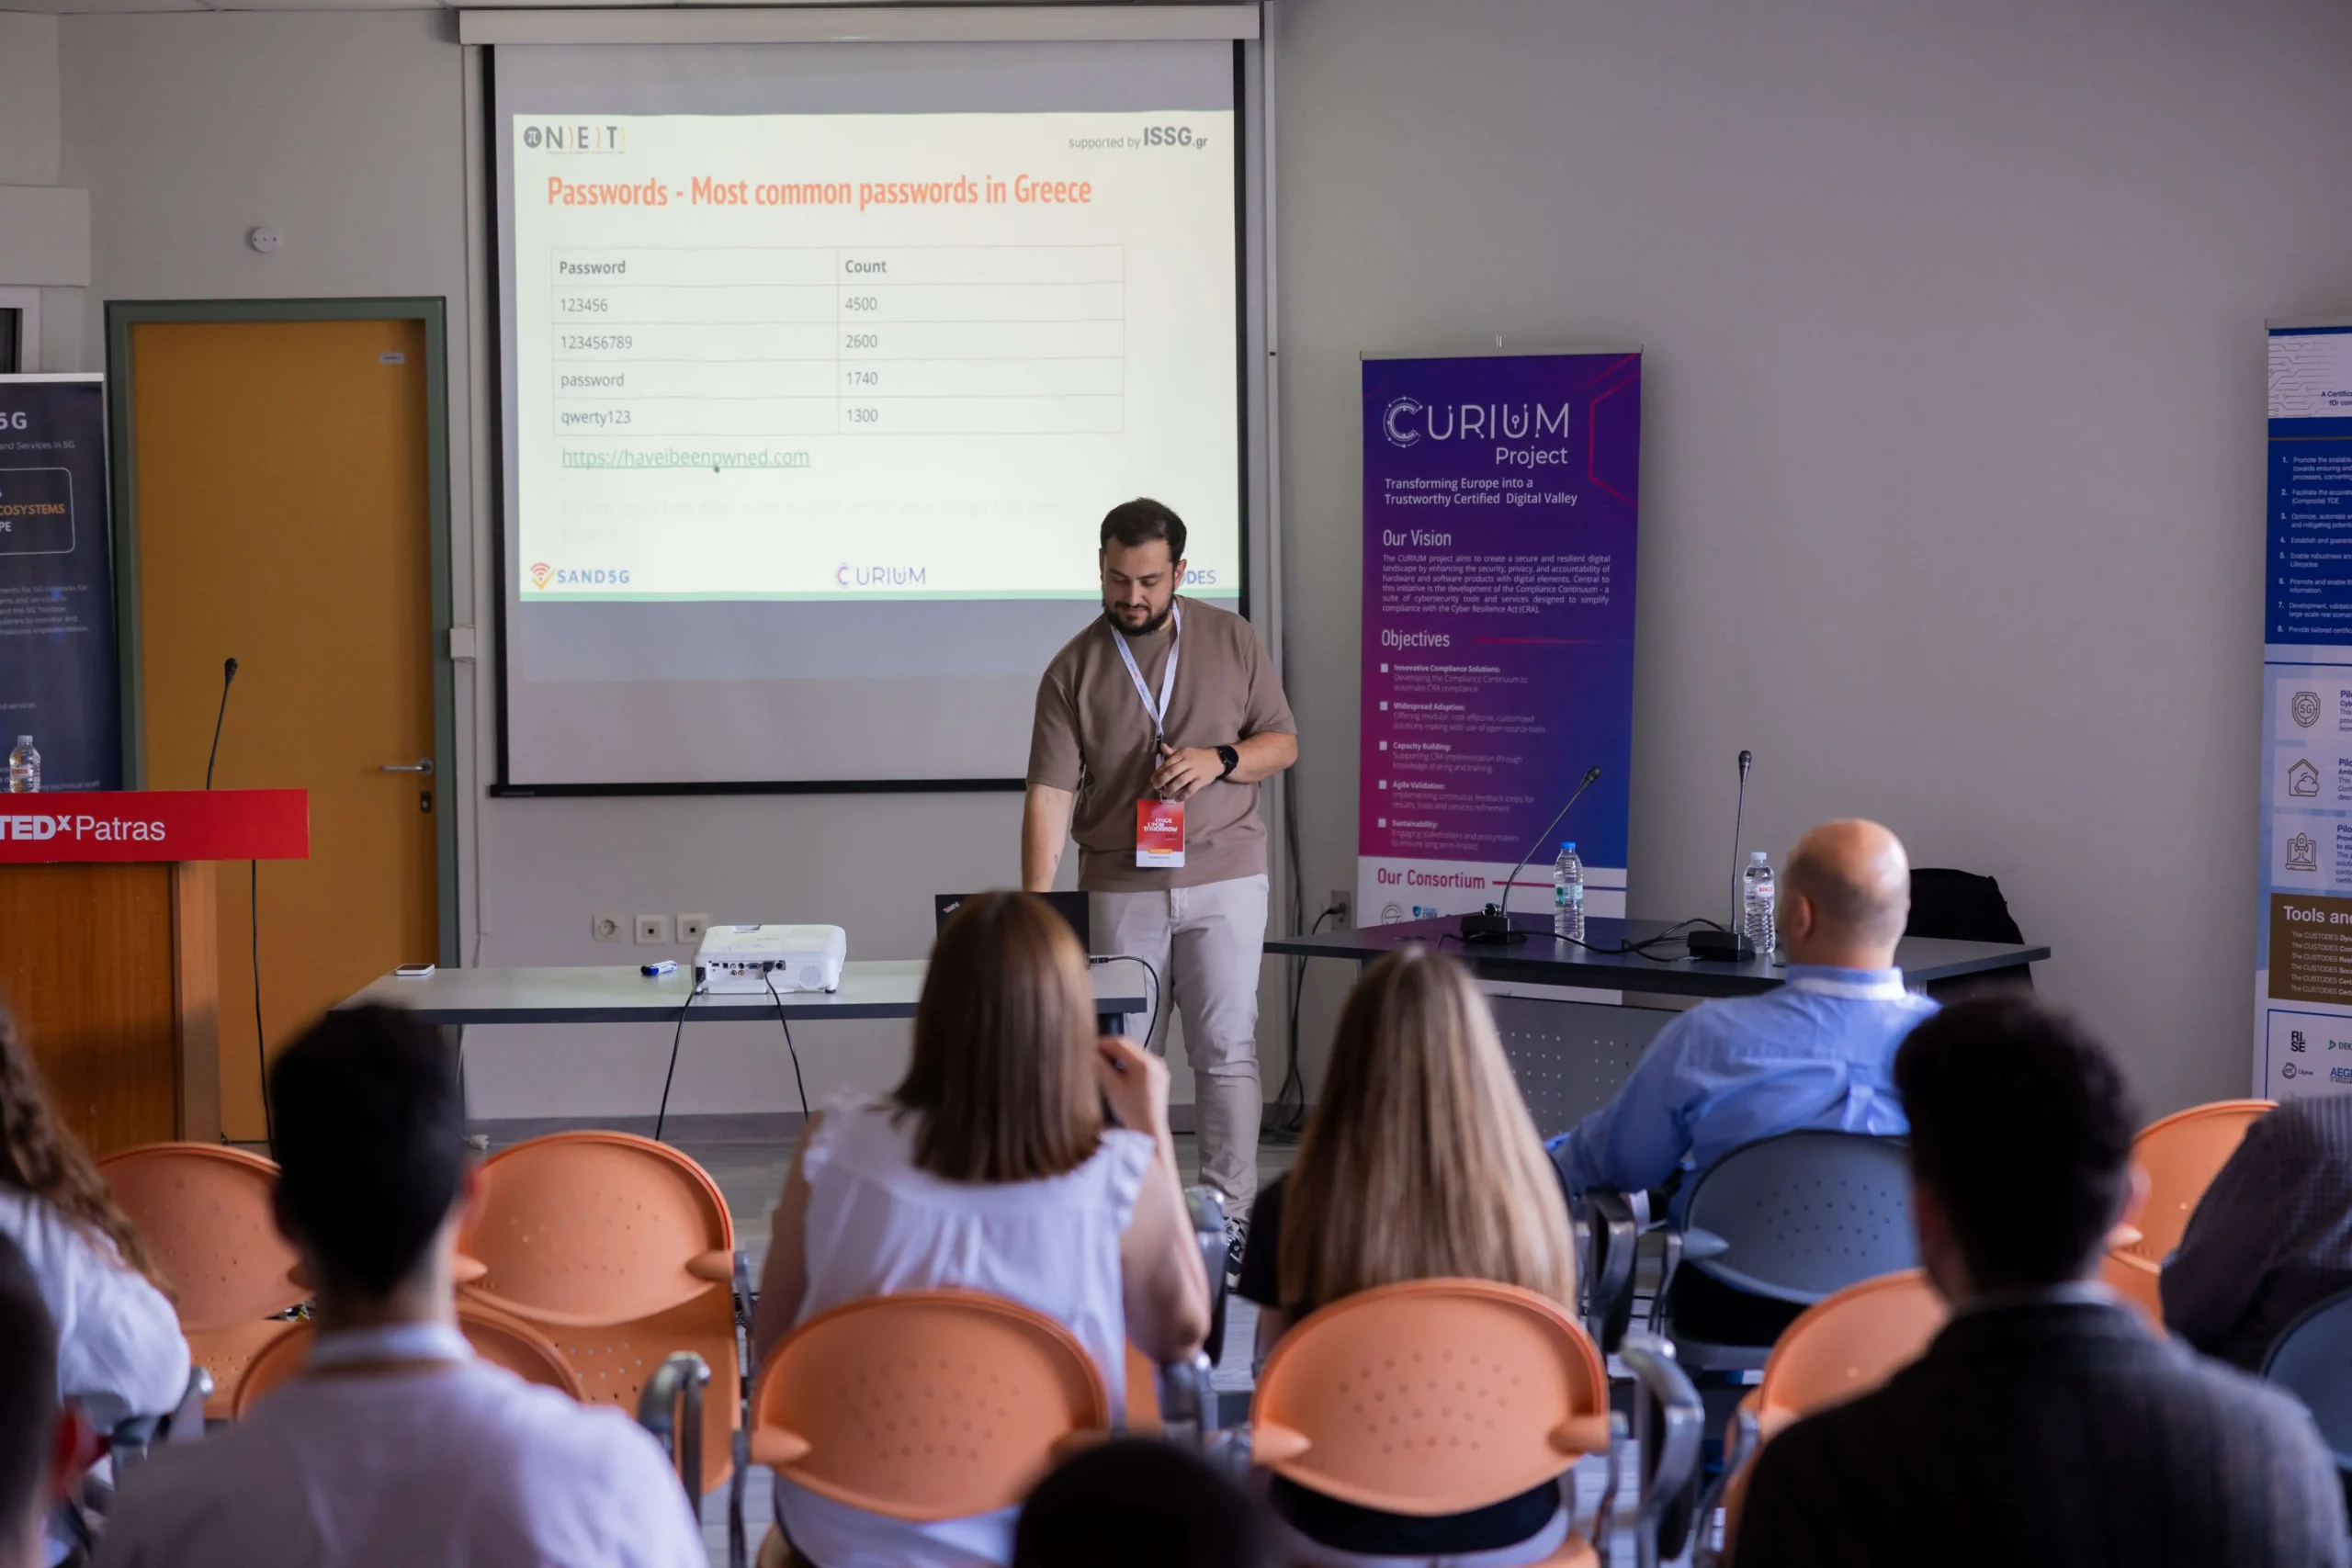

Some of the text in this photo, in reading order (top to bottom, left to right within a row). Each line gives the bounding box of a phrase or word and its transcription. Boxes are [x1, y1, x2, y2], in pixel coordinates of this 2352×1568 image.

[1069, 127, 1208, 150] supported by ISSG.gr
[548, 176, 668, 206] Passwords
[691, 176, 748, 206] Most
[755, 182, 852, 206] common
[860, 175, 978, 210] passwords
[985, 175, 1006, 204] in
[1014, 174, 1091, 204] Greece
[560, 260, 626, 275] Password
[844, 260, 887, 274] Count
[560, 298, 608, 312] 123456
[844, 297, 877, 311] 4500
[560, 335, 633, 350] 123456789
[845, 334, 878, 348] 2600
[560, 373, 625, 389] password
[845, 372, 878, 386] 1740
[560, 411, 631, 427] qwerty123
[846, 409, 878, 423] 1300
[1383, 396, 1569, 448] CURIUM
[16, 442, 52, 450] Services
[561, 447, 810, 469] https://haveibeenpwned.com
[1496, 446, 1568, 468] Project
[1385, 478, 1533, 491] Transforming Europe into a
[1385, 492, 1577, 507] Trustworthy Certified Digital Valley
[1383, 529, 1452, 547] Our Vision
[1398, 555, 1426, 563] CURIUM
[1430, 555, 1453, 564] project
[1541, 555, 1555, 563] and
[1557, 555, 1585, 563] resilient
[1588, 555, 1611, 564] digital
[557, 569, 630, 584] SAND5G
[836, 563, 926, 589] CURIUM
[1383, 565, 1417, 574] landscape
[1419, 565, 1427, 574] by
[1429, 565, 1464, 574] enhancing
[1478, 565, 1507, 574] security,
[1536, 565, 1550, 573] and
[1552, 565, 1600, 574] accountability
[1602, 565, 1610, 573] of
[1464, 575, 1495, 584] products
[1497, 575, 1511, 583] with
[1514, 575, 1534, 584] digital
[1537, 575, 1571, 583] elements.
[1383, 584, 1395, 592] this
[1396, 584, 1425, 592] initiative
[1428, 584, 1433, 592] is
[1434, 584, 1446, 592] the
[1448, 585, 1492, 593] development
[1516, 585, 1555, 594] Compliance
[1382, 594, 1398, 603] suite
[1415, 595, 1459, 604] cybersecurity
[1532, 596, 1565, 604] designed
[1580, 596, 1609, 605] simplify
[1382, 604, 1420, 614] compliance
[1451, 605, 1470, 615] Cyber
[1382, 629, 1450, 650] Objectives
[1430, 665, 1467, 673] Compliance
[1468, 665, 1500, 673] Solutions:
[2341, 690, 2352, 698] Pil
[1394, 703, 1465, 712] Widespread Adoption:
[1393, 742, 1452, 751] Capacity Building:
[1393, 782, 1445, 790] Agile Validation:
[1392, 819, 1438, 829] Sustainability:
[1378, 868, 1485, 889] Our Consortium
[2283, 905, 2352, 924] Tools an
